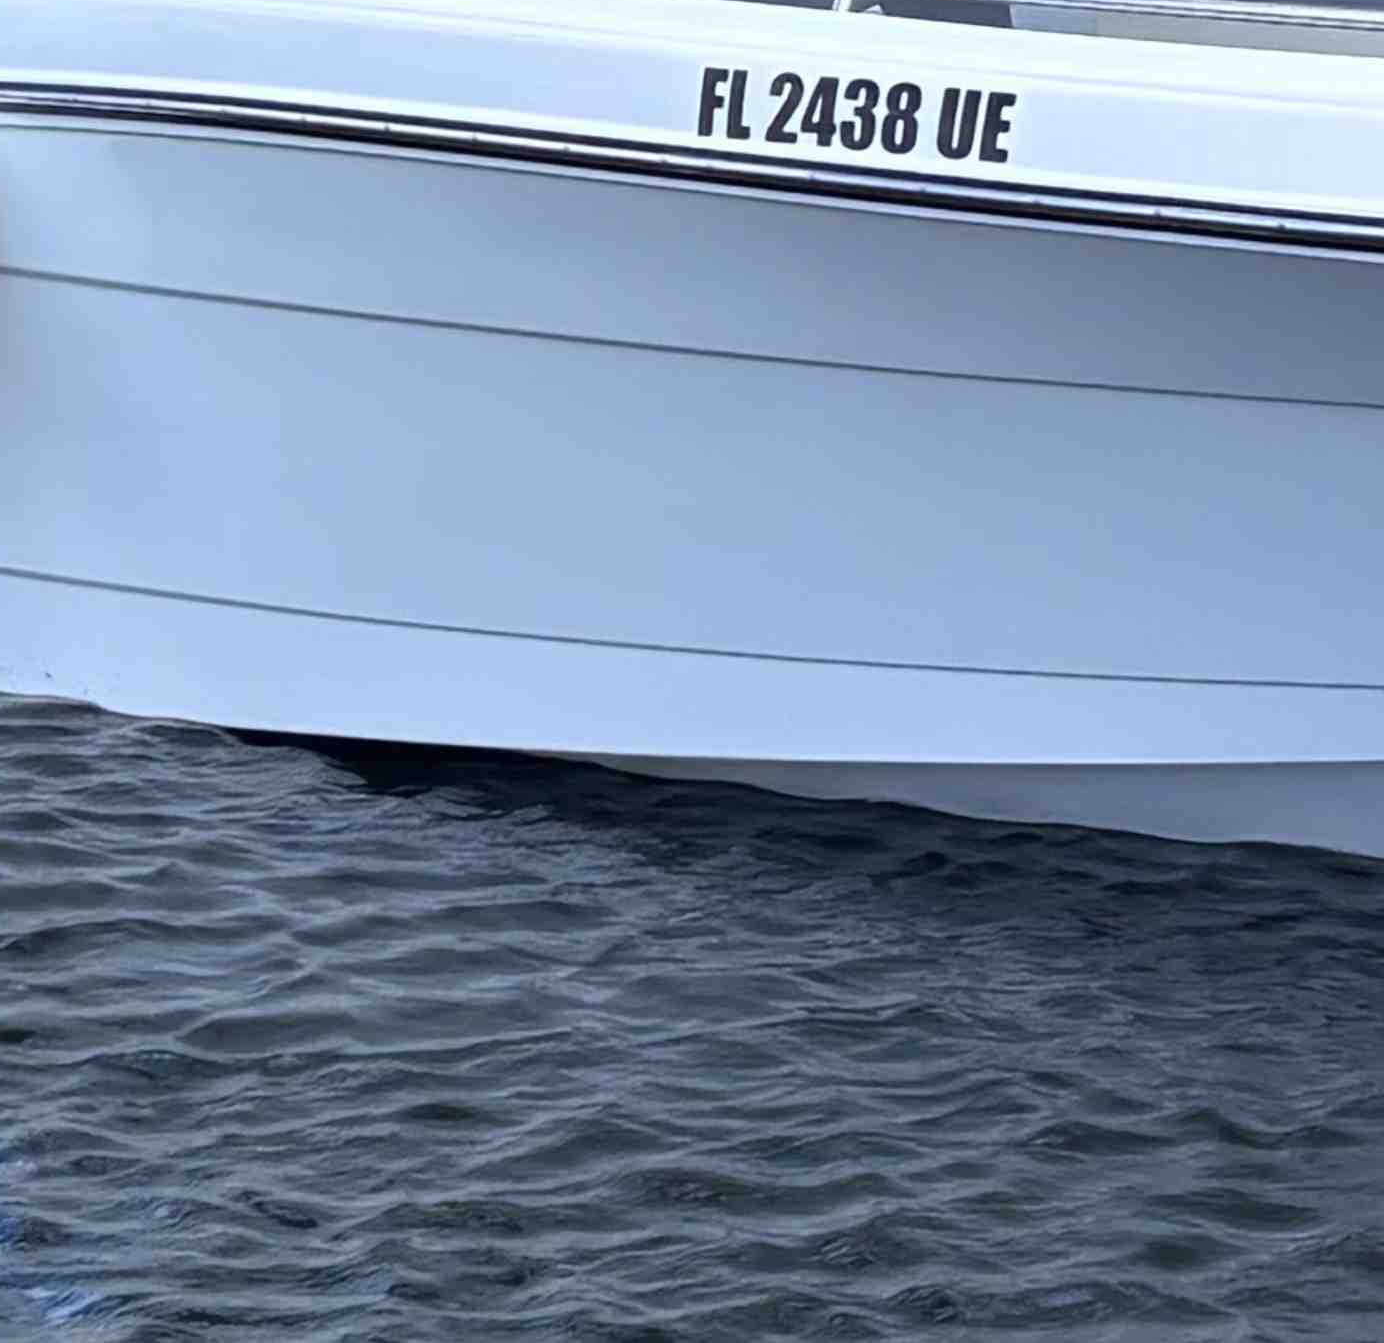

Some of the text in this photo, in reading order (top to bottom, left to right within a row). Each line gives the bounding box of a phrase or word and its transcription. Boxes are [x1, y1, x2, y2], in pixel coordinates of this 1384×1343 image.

[697, 66, 1017, 164] FL 2438 UE
